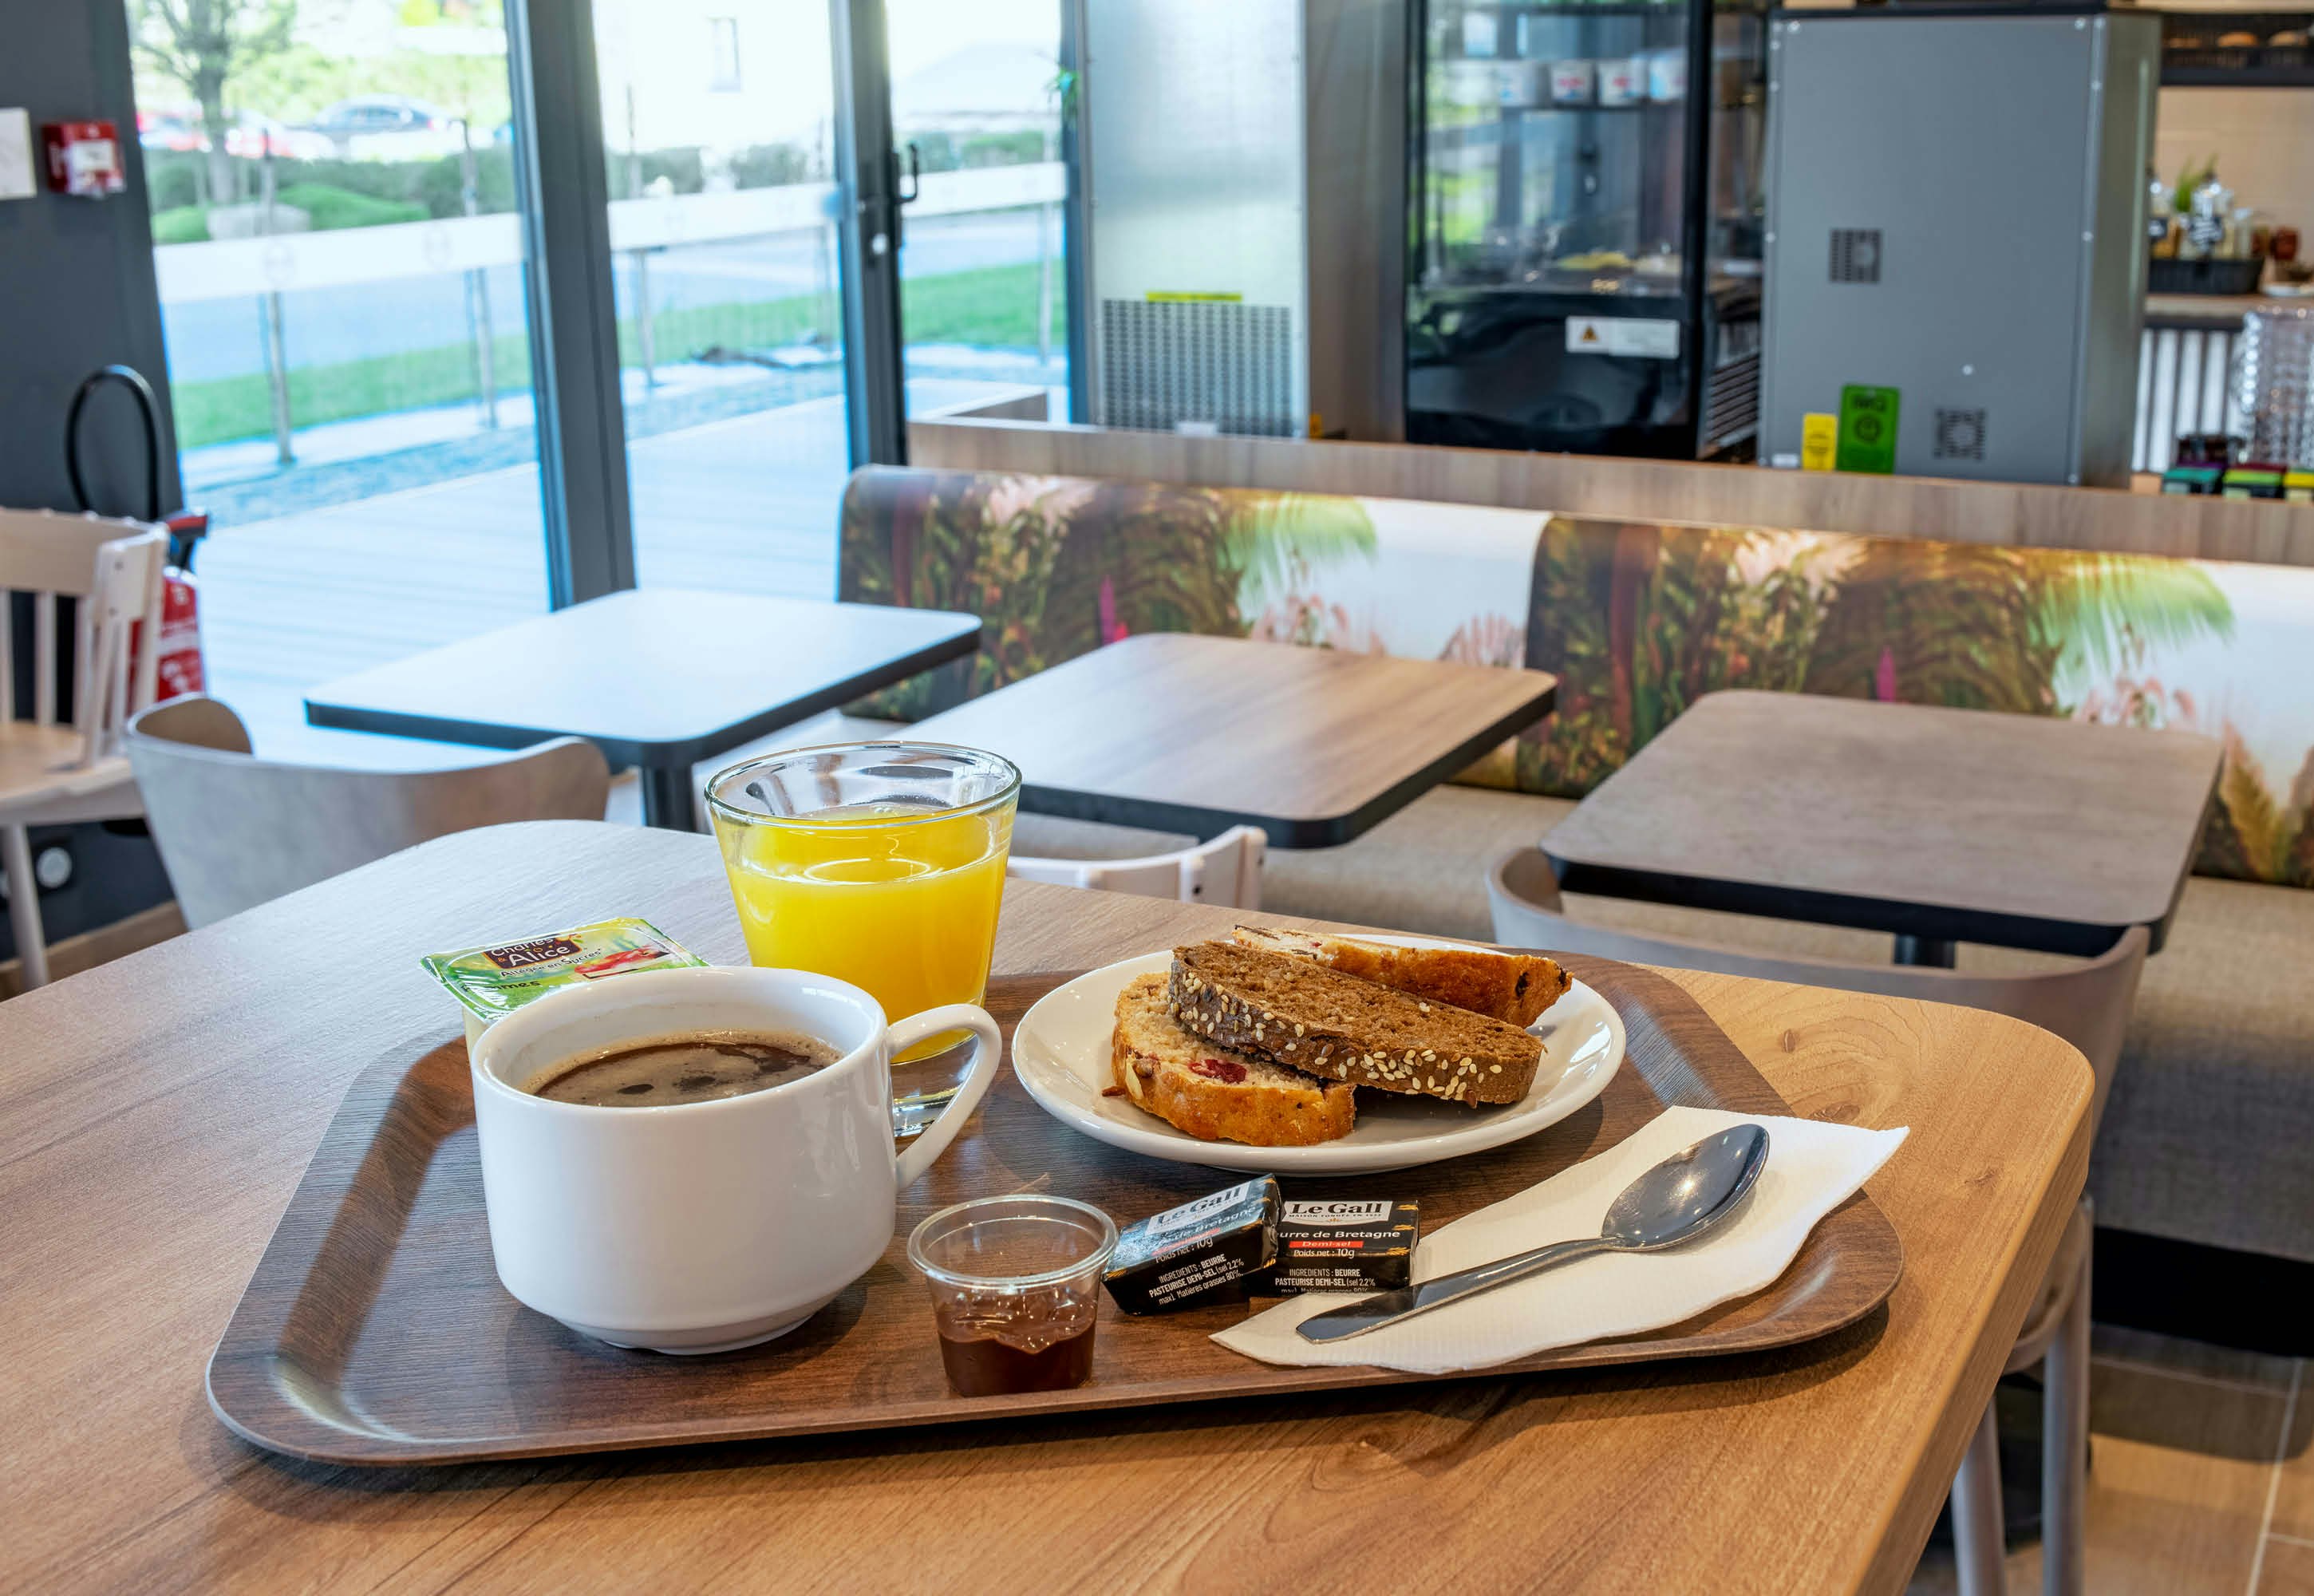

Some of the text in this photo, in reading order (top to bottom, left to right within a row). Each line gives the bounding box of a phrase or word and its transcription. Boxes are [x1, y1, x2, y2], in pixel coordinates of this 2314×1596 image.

[491, 937, 554, 957] Charles
[508, 946, 571, 967] Alice
[1157, 1211, 1184, 1225] Le
[1190, 1187, 1242, 1213] Gall
[1290, 1203, 1382, 1214] Le Gall
[1197, 1237, 1214, 1250] 10g
[1337, 1249, 1355, 1259] 10g
[1158, 1264, 1198, 1283] INGREDIENTS
[1200, 1254, 1227, 1270] BEURRE
[1289, 1268, 1330, 1277] INGREDIENTS
[1148, 1278, 1187, 1298] PASTEURISE
[1187, 1268, 1218, 1285] DEMI-SEL
[1176, 1284, 1202, 1298] Matières
[1202, 1275, 1226, 1291] grasses
[1274, 1278, 1315, 1286] PASTEURISE
[1315, 1278, 1346, 1286] DEMI-SEL
